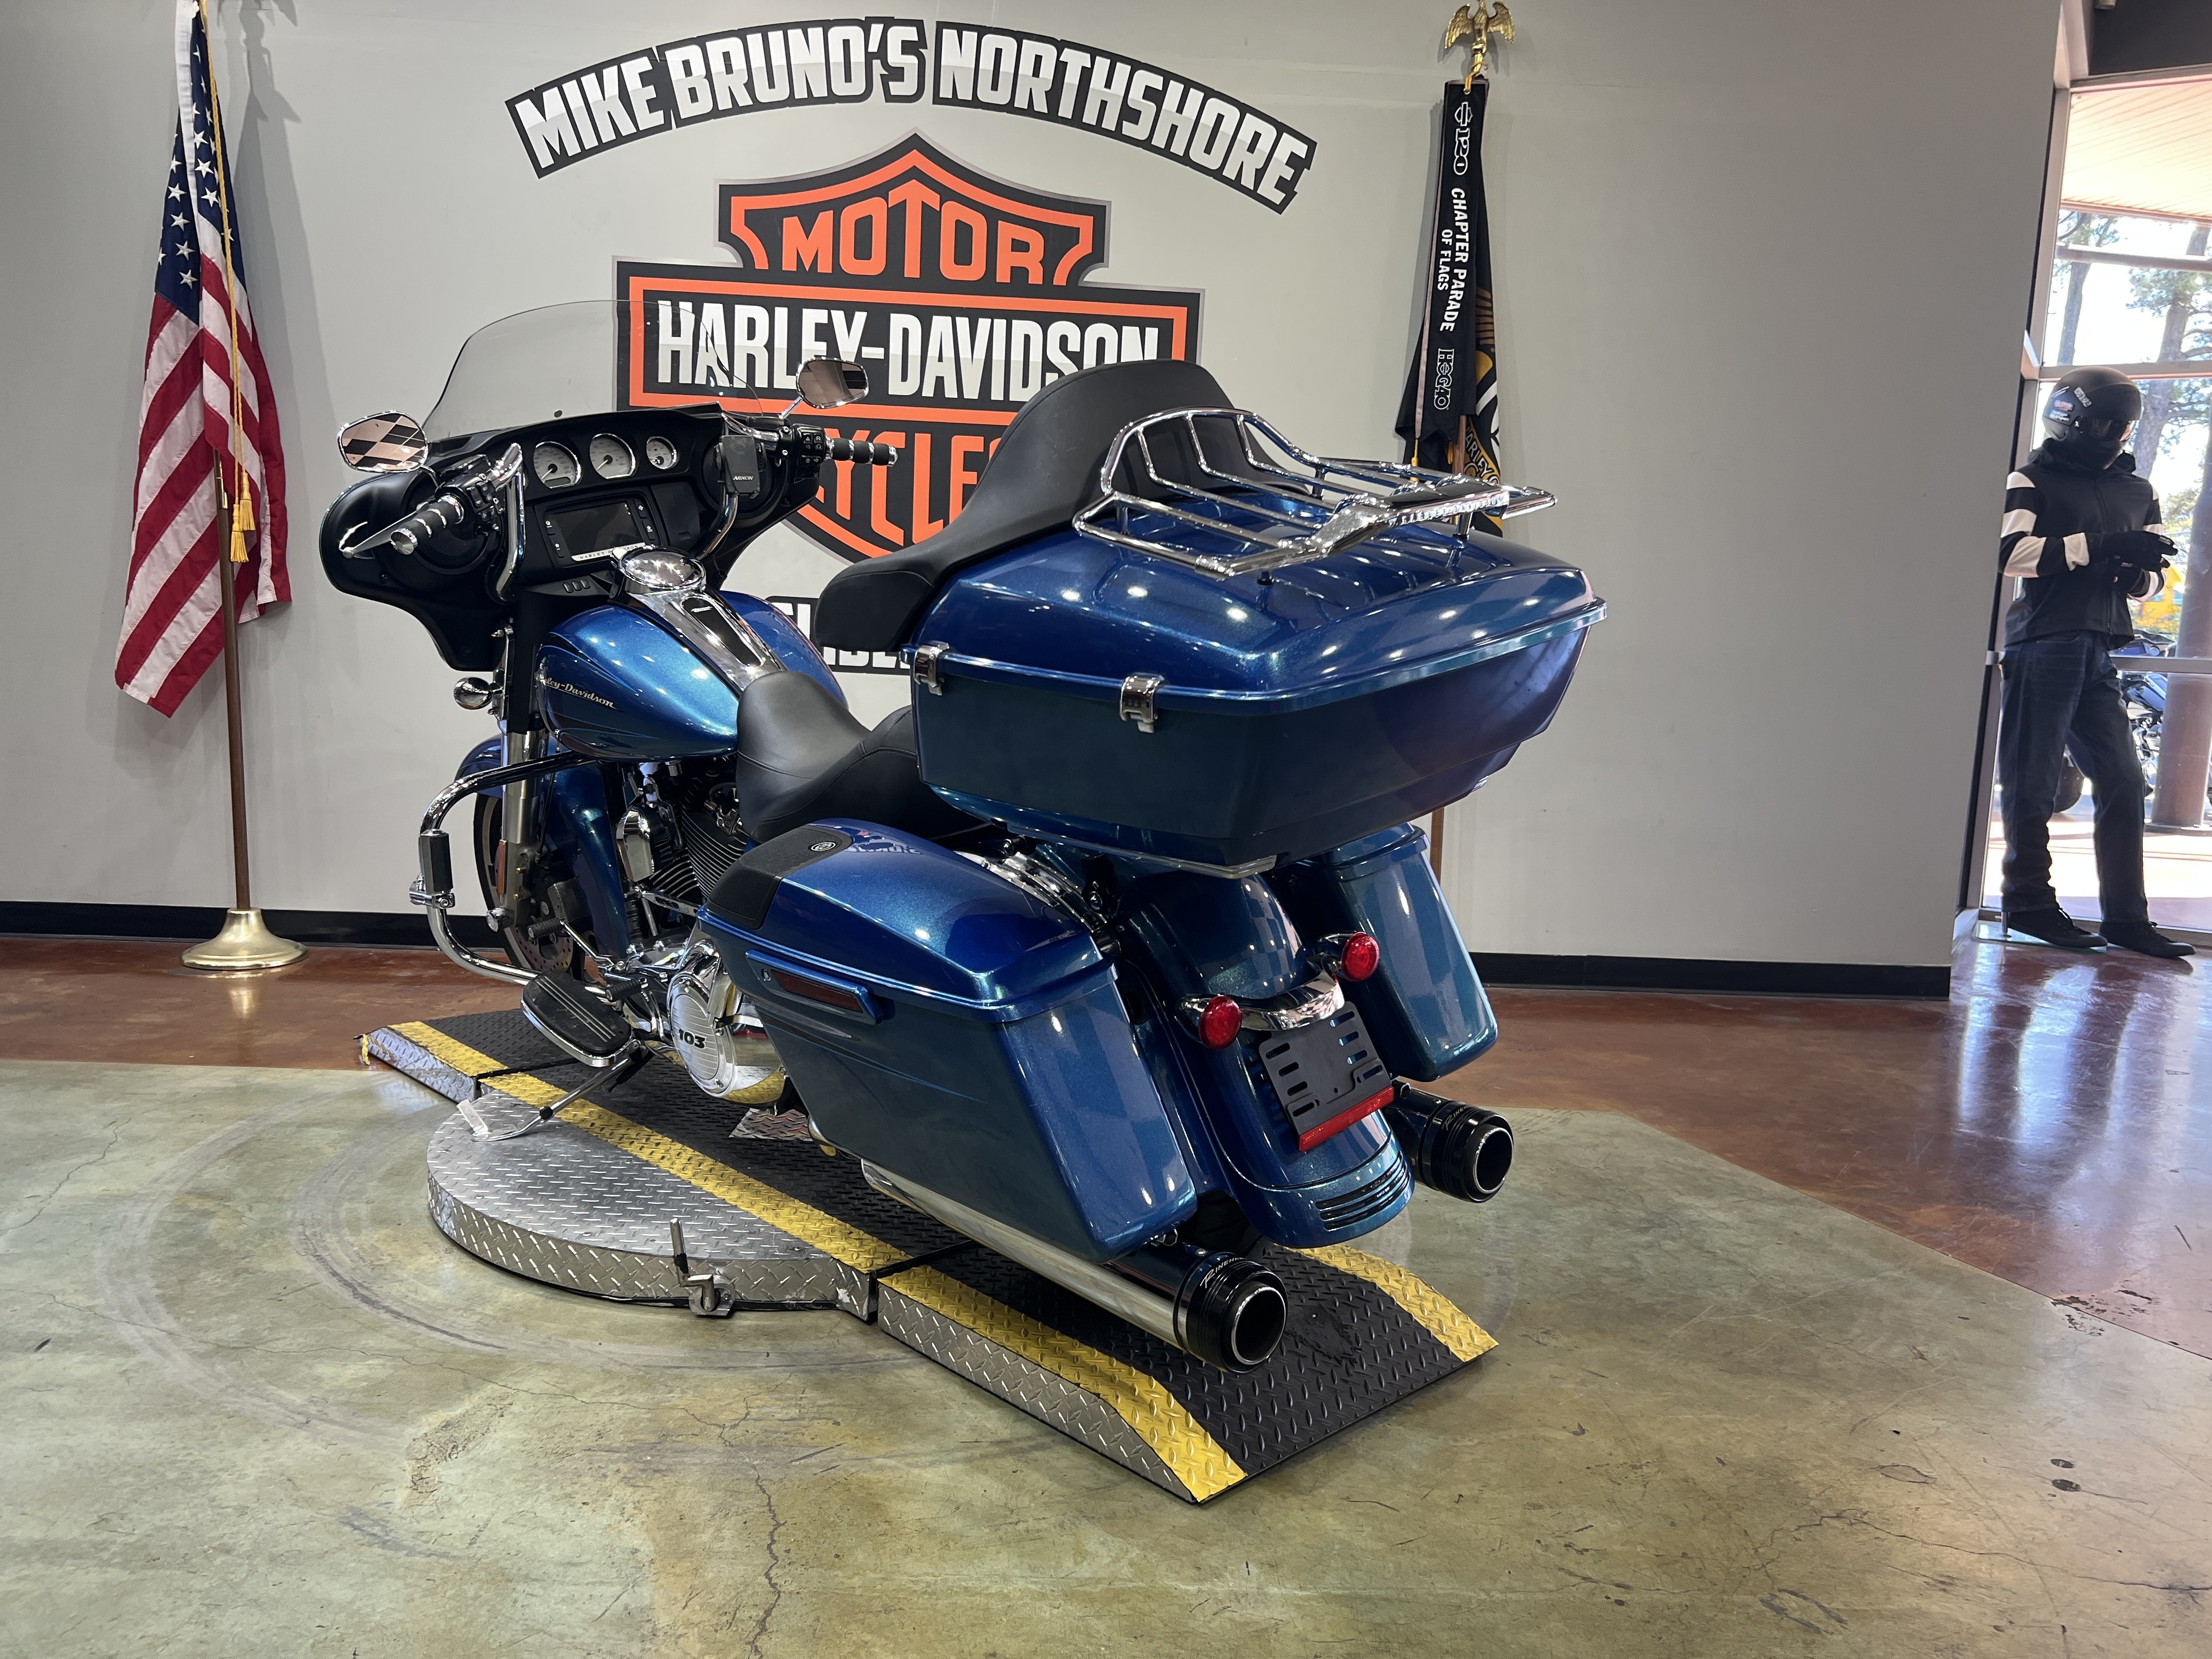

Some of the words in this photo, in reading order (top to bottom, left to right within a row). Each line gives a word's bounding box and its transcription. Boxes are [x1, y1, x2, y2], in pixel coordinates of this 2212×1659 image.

[515, 56, 664, 168] MIKE
[665, 24, 919, 119] BRUNO'S
[939, 29, 1308, 205] NORTHSHORE
[782, 179, 1045, 284] MOTOR
[1441, 229, 1453, 246] OF
[1451, 188, 1469, 263] CHAPTER
[1437, 250, 1451, 291] FLAGS
[1440, 269, 1467, 331] PARADE
[816, 428, 1002, 546] YCLE
[678, 1029, 706, 1049] 103
